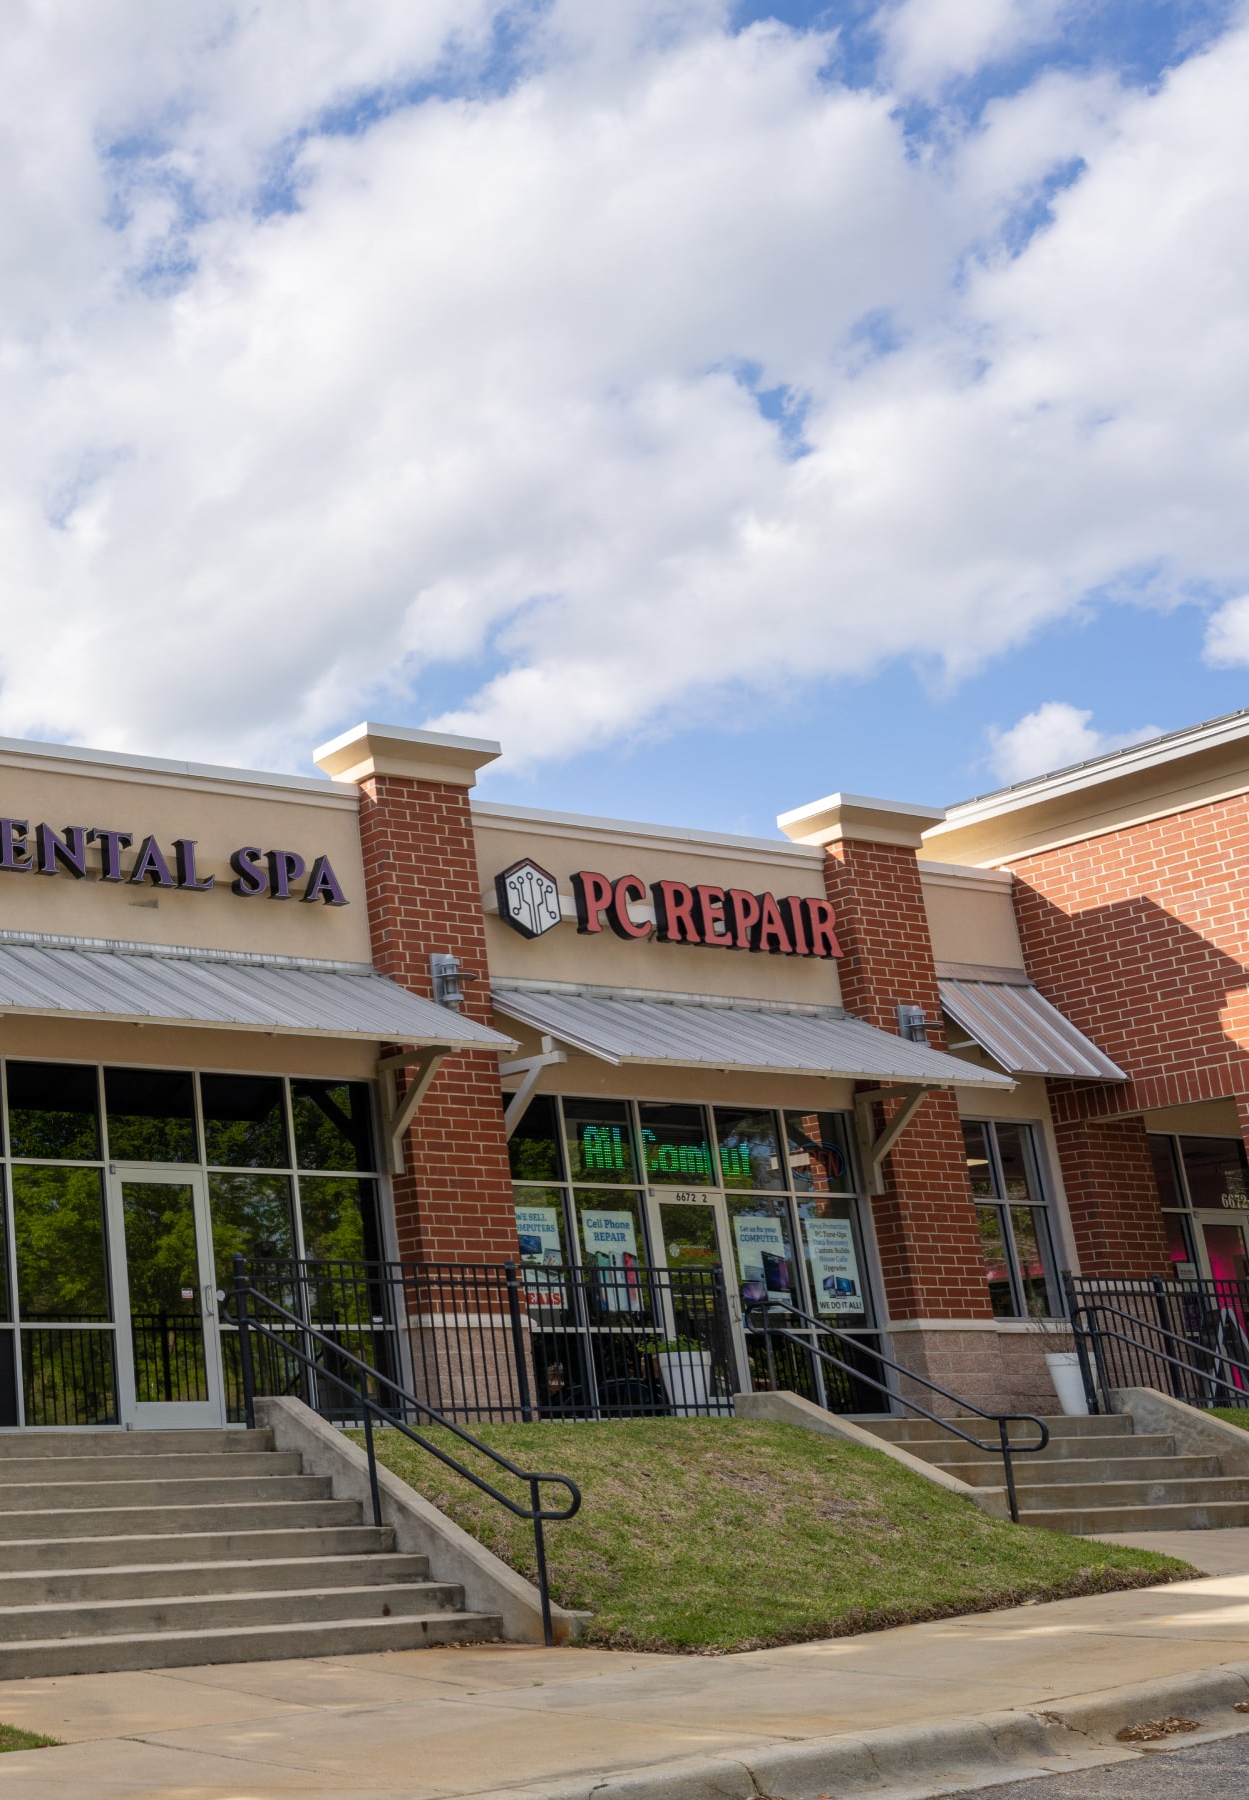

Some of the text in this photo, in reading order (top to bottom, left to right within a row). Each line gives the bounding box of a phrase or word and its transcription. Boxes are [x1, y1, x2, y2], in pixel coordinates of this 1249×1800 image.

[230, 846, 350, 907] SPA
[570, 871, 844, 960] PC REPAIR
[641, 1129, 752, 1177] Comut
[794, 1148, 841, 1177] PEN
[676, 1192, 708, 1203] 6672 2
[515, 1213, 547, 1221] WE SELL
[517, 1224, 556, 1232] MPUTERS
[586, 1219, 630, 1229] Cell Phone
[593, 1232, 626, 1242] REPAIR
[740, 1234, 779, 1242] COMPUTER
[825, 1239, 848, 1247] Recovery
[823, 1264, 847, 1272] Upgrades
[819, 1301, 862, 1309] WE DO IT ALL!
